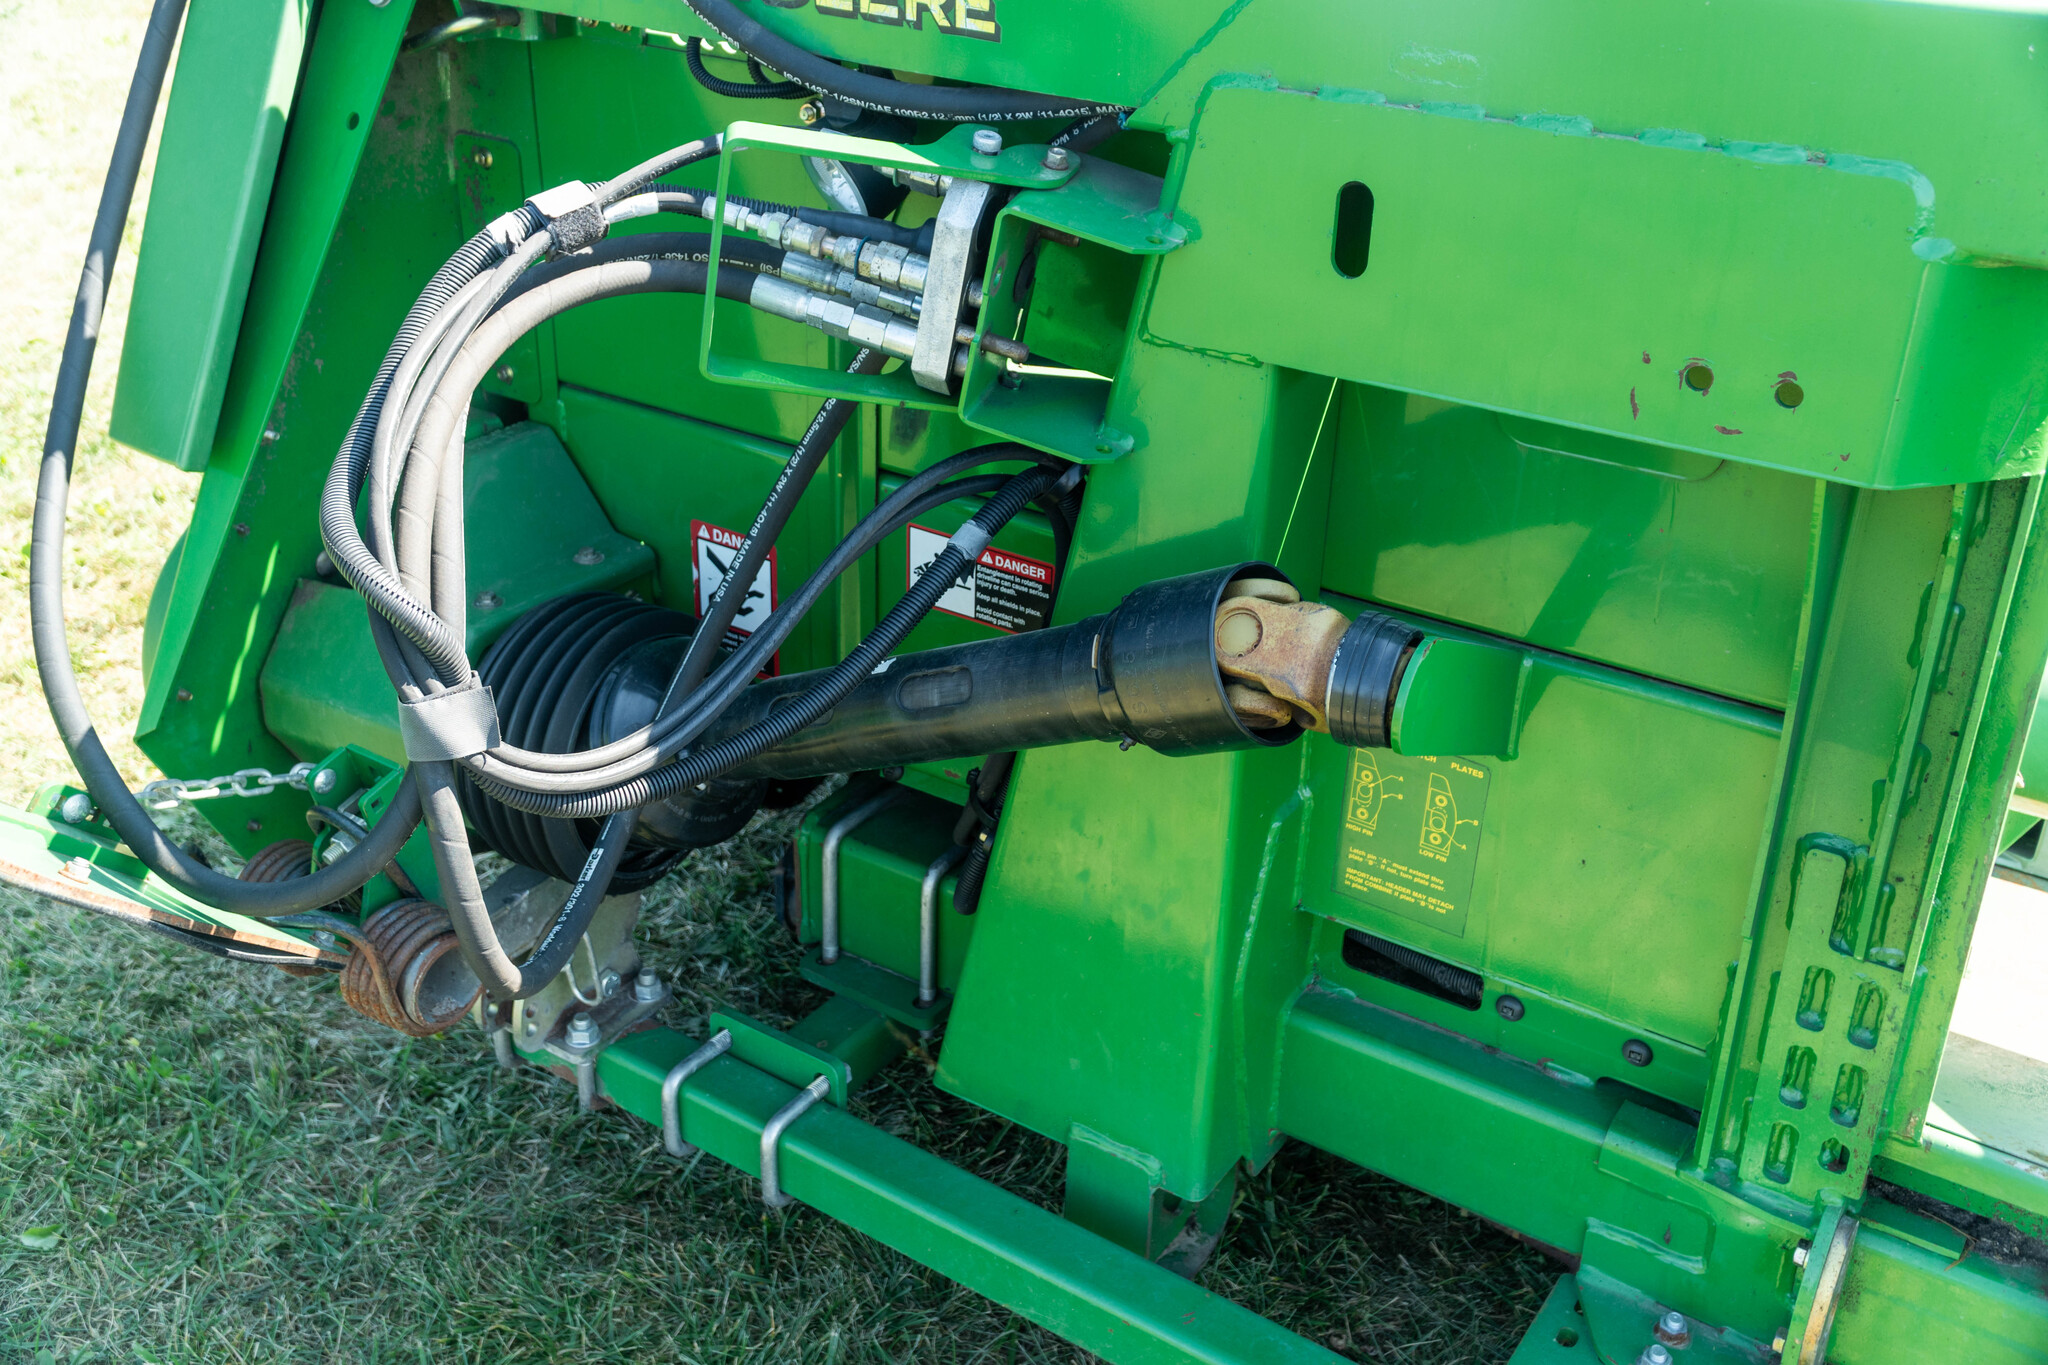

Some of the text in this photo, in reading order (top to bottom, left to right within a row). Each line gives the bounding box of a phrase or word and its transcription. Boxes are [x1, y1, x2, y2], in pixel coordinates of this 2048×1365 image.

[784, 71, 802, 84] ISO
[1004, 113, 1013, 121] X
[692, 252, 710, 262] SO
[760, 262, 780, 277] PSI)
[803, 410, 827, 445] 12.5mm
[790, 446, 806, 468] (1/2)
[784, 466, 793, 476] X
[776, 475, 788, 492] 2W
[735, 538, 752, 570] MADE
[726, 570, 736, 582] IN
[977, 564, 1014, 582] Entanglement
[1021, 578, 1042, 590] rotating
[995, 556, 1045, 580] DANGER
[712, 582, 730, 602] USA
[977, 572, 1000, 584] driveline
[1012, 583, 1028, 592] cause
[1029, 588, 1049, 599] serious
[977, 579, 992, 590] injury
[1000, 586, 1017, 596] death.
[976, 592, 990, 602] Keep
[999, 599, 1018, 610] shields
[1026, 608, 1042, 617] place.
[976, 605, 1025, 625] Avoid contact with
[976, 613, 1013, 628] rotating parts.
[1451, 762, 1484, 779] PLATES
[1346, 823, 1374, 837] HIGH PIN
[1350, 846, 1366, 856] Latch
[1392, 862, 1408, 872] must
[1409, 868, 1430, 880] extend
[1431, 875, 1444, 884] thru
[1419, 848, 1447, 863] LOW PIN
[1348, 854, 1363, 862] plate
[1387, 867, 1398, 875] not,
[1400, 871, 1413, 880] turn
[1414, 877, 1429, 886] plate
[1430, 882, 1446, 892] over.
[1345, 873, 1363, 884] FROM
[1364, 881, 1393, 895] COMBINE
[1400, 894, 1415, 903] plate
[1346, 867, 1454, 911] IMPORTANT: HEADER MAY DETACH
[1351, 883, 1369, 892] place.
